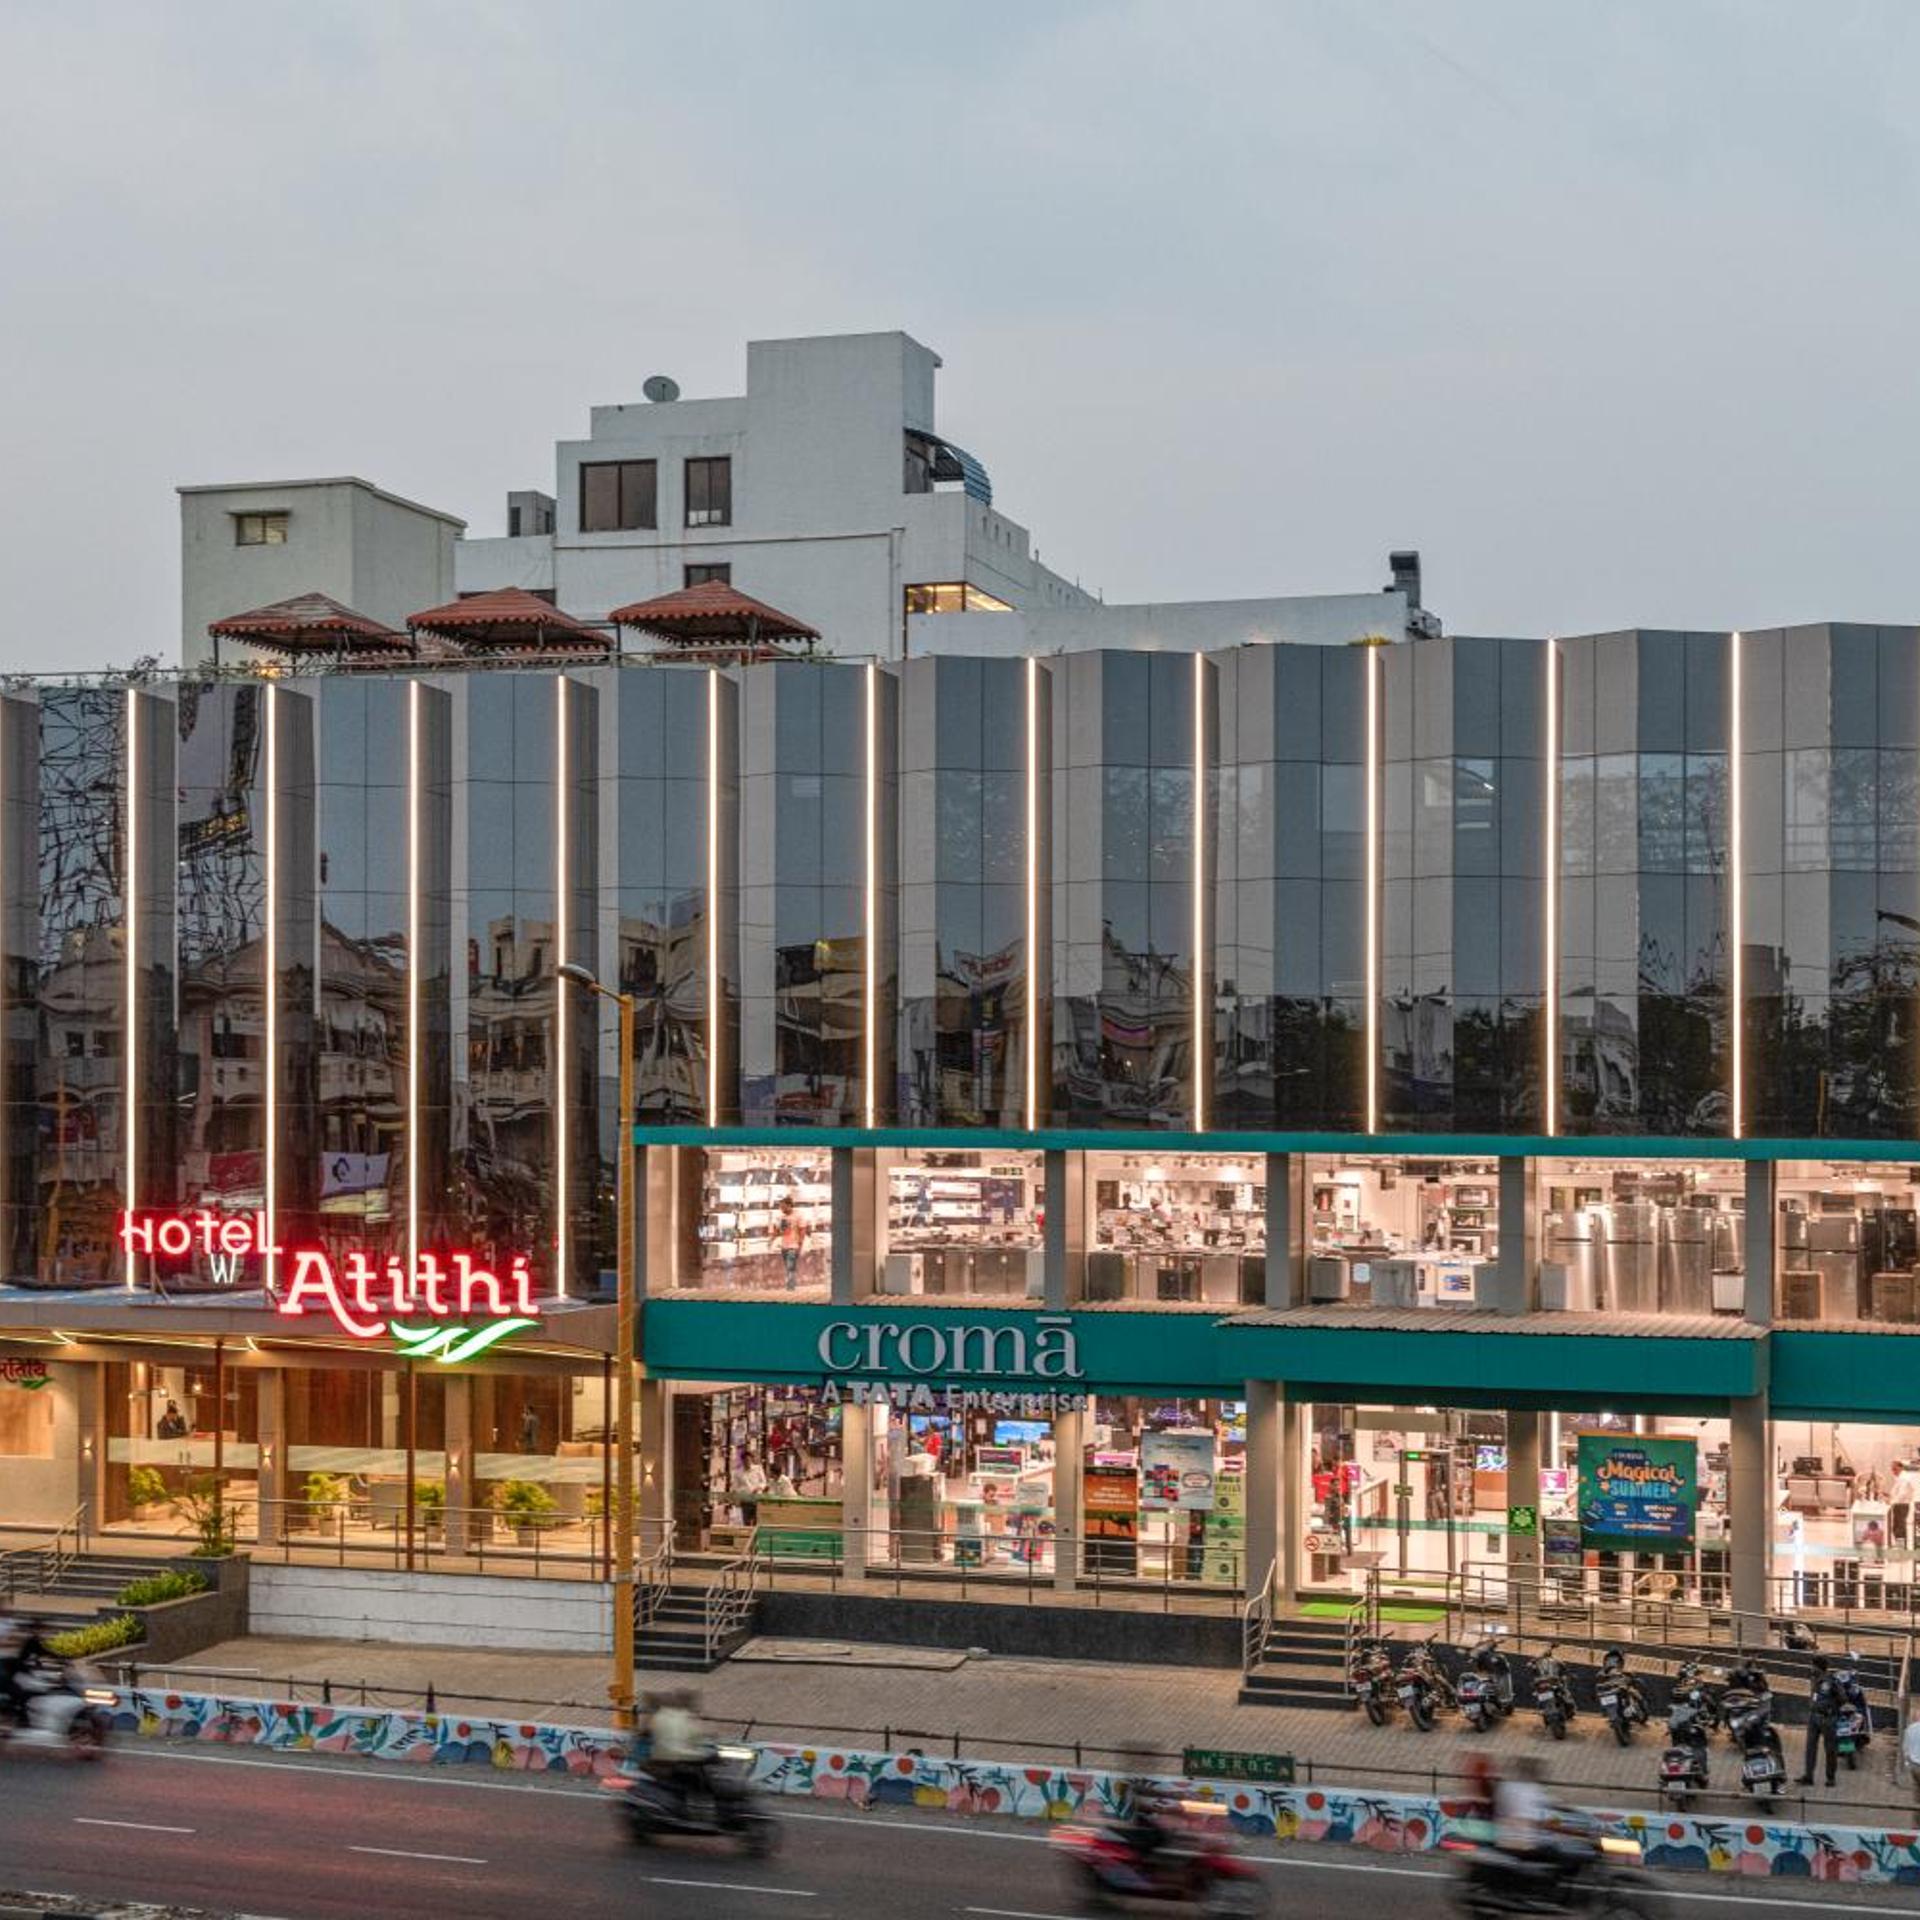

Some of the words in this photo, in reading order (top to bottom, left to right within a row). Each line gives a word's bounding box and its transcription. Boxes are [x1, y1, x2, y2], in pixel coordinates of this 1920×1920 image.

[279, 1251, 539, 1338] Atithi
[822, 1380, 841, 1404] A
[847, 1381, 935, 1408] TATA
[945, 1384, 1089, 1412] Enterprise
[1599, 1459, 1685, 1485] Magical
[1610, 1480, 1670, 1499] SUMMER
